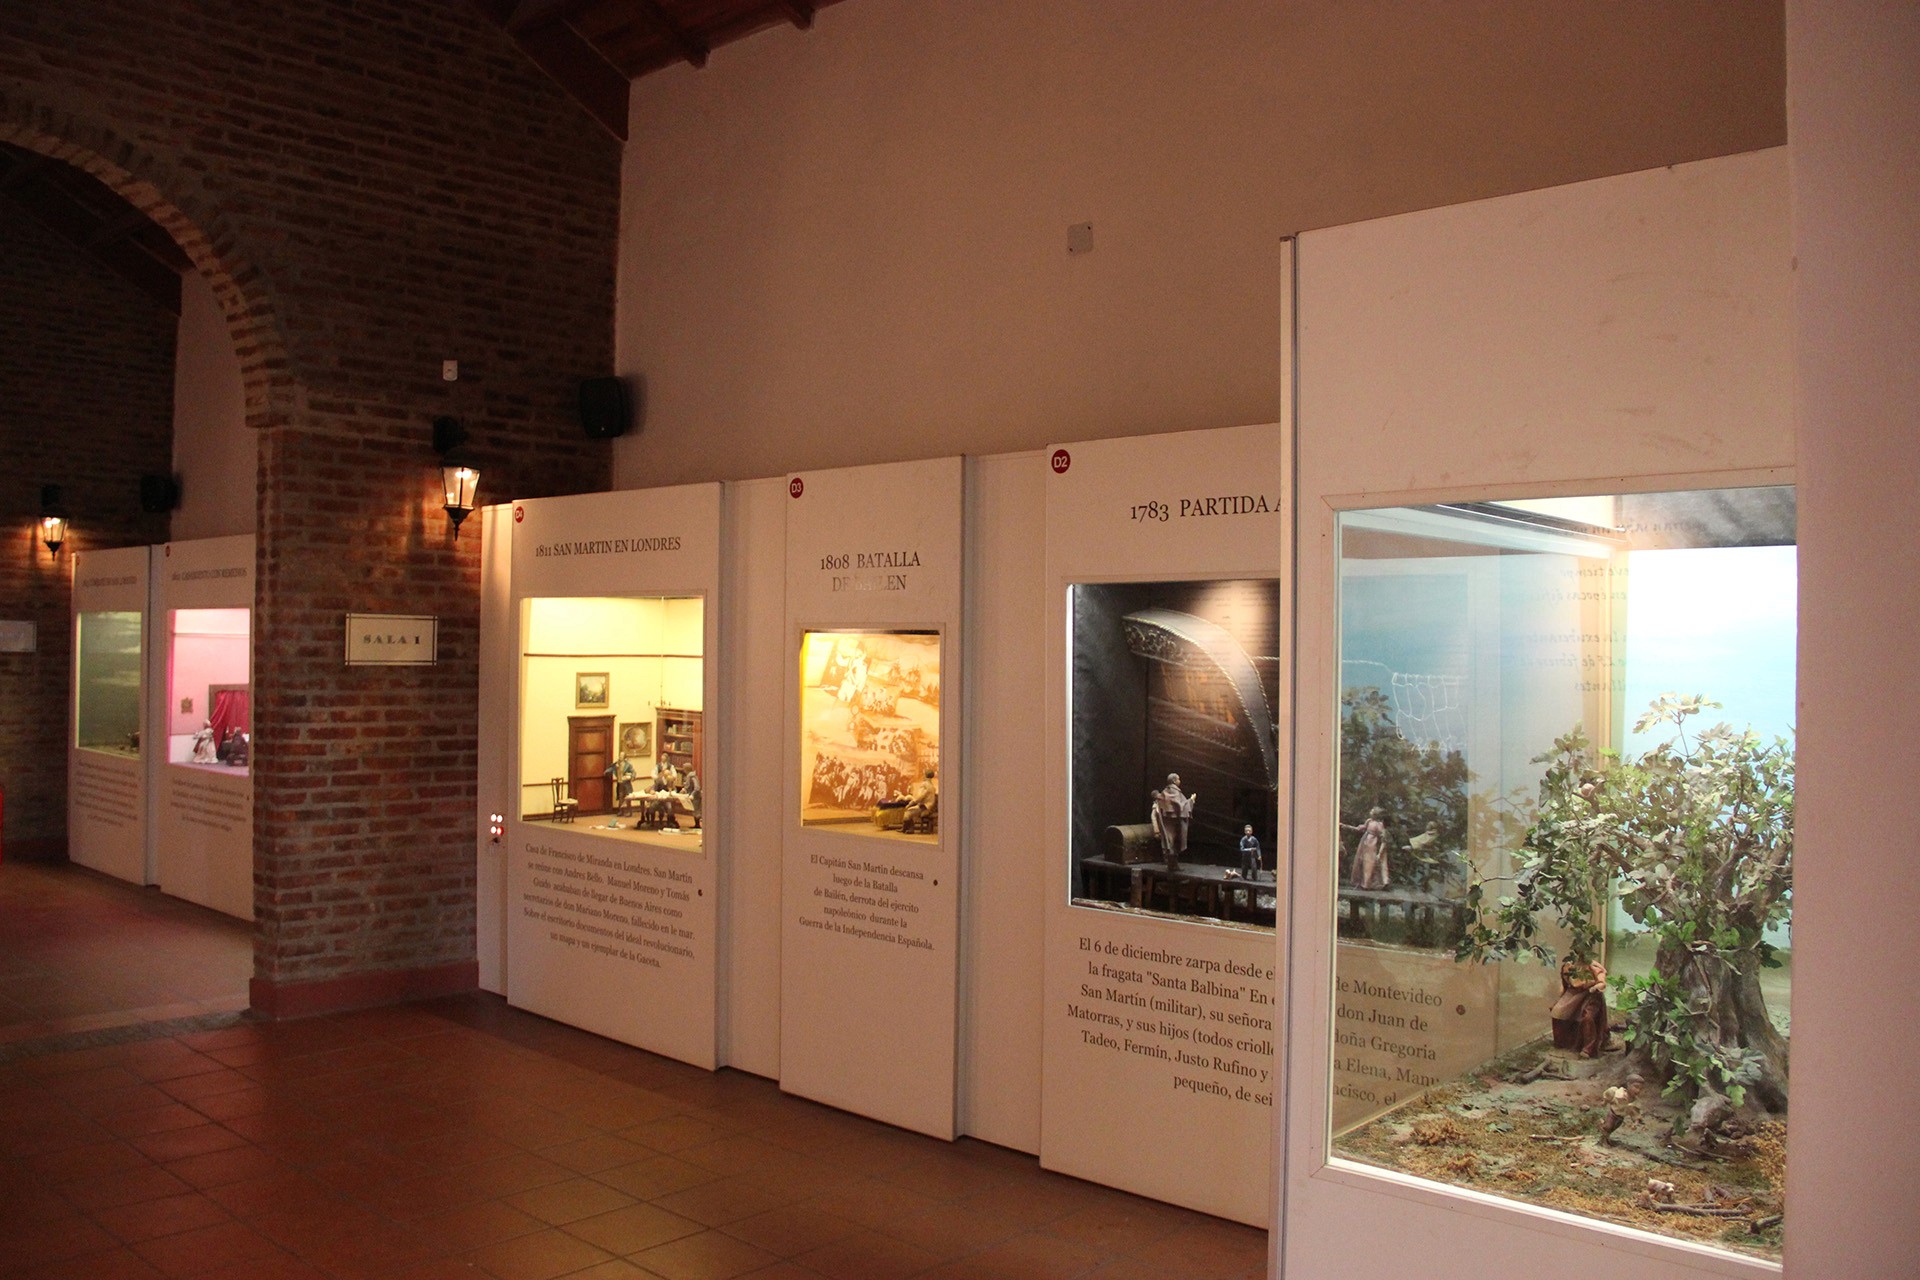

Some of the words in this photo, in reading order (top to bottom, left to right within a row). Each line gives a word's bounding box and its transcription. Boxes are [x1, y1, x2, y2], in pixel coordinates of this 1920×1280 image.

[1054, 456, 1068, 469] D2
[792, 483, 802, 494] D3
[1131, 501, 1169, 522] 1783
[1180, 495, 1269, 517] PARTIDA
[536, 544, 552, 557] 1811
[554, 543, 572, 556] SAN
[574, 541, 612, 555] MARTIN
[615, 540, 629, 553] EN
[631, 537, 681, 552] LONDRES
[821, 554, 850, 570] 1808
[857, 552, 921, 569] BATALLA
[364, 634, 406, 645] SALA
[526, 843, 539, 854] Casa
[540, 845, 547, 855] de
[549, 848, 576, 861] Francisco
[577, 853, 585, 863] de
[586, 854, 613, 868] Miranda
[614, 862, 622, 870] en
[654, 867, 667, 878] San
[811, 855, 818, 864] El
[819, 856, 846, 869] Capitán
[848, 860, 861, 871] San
[890, 866, 924, 880] descansa
[552, 867, 563, 875] con
[608, 875, 632, 889] Manuel
[633, 881, 660, 895] Moreno
[660, 889, 666, 898] y
[833, 874, 852, 887] luego
[854, 877, 863, 887] de
[864, 878, 871, 889] la
[873, 880, 898, 893] Batalla
[582, 887, 590, 898] de
[591, 889, 609, 903] llegar
[610, 894, 618, 904] de
[619, 896, 643, 910] Buenos
[644, 902, 662, 914] Aires
[664, 908, 683, 918] como
[814, 886, 823, 897] de
[850, 892, 876, 906] derrota
[878, 897, 889, 909] del
[524, 908, 540, 919] Sobre
[547, 915, 575, 928] escritorio
[576, 920, 613, 938] documentos
[615, 930, 625, 941] del
[626, 932, 642, 945] ideal
[555, 898, 562, 908] de
[563, 900, 575, 912] don
[576, 903, 602, 917] Mariano
[631, 916, 660, 931] fallecido
[661, 926, 670, 934] en
[870, 914, 899, 928] durante
[901, 918, 908, 929] la
[799, 916, 823, 930] Guerra
[824, 921, 833, 931] de
[835, 923, 841, 933] la
[843, 924, 896, 944] Independencia
[898, 935, 935, 951] Española.
[559, 934, 575, 946] mapa
[582, 941, 590, 949] un
[591, 943, 619, 956] ejemplar
[620, 949, 628, 960] de
[630, 950, 635, 961] la
[1079, 937, 1091, 951] El
[1094, 941, 1102, 953] 6
[1105, 941, 1119, 956] de
[1122, 944, 1183, 966] diciembre
[1186, 957, 1221, 974] zarpa
[1225, 960, 1262, 979] desde
[1088, 961, 1099, 976] la
[1102, 964, 1143, 983] fragata
[1147, 971, 1187, 991] "Santa
[1191, 979, 1246, 1000] Balbina"
[1250, 989, 1267, 1005] En
[1354, 980, 1442, 1007] Montevideo
[1081, 984, 1102, 1000] San
[1106, 988, 1146, 1008] Martín
[1150, 996, 1206, 1021] (militar),
[1210, 1009, 1224, 1022] su
[1228, 1012, 1272, 1031] señora
[1337, 1004, 1364, 1022] don
[1368, 1010, 1405, 1029] Juan
[1410, 1015, 1428, 1032] de
[1067, 1004, 1123, 1030] Matorras,
[1126, 1018, 1134, 1031] y
[1136, 1019, 1156, 1034] sus
[1160, 1021, 1189, 1040] hijos
[1193, 1028, 1233, 1049] (todos
[1081, 1030, 1120, 1050] Tadeo,
[1124, 1039, 1172, 1062] Fermín,
[1175, 1050, 1209, 1069] Justo
[1213, 1057, 1257, 1078] Rufino
[1261, 1069, 1269, 1082] y
[1371, 1036, 1436, 1061] Gregoria
[1347, 1058, 1391, 1081] Elena,
[1174, 1075, 1232, 1099] pequeño,
[1236, 1086, 1251, 1102] de
[1384, 1093, 1397, 1106] el
